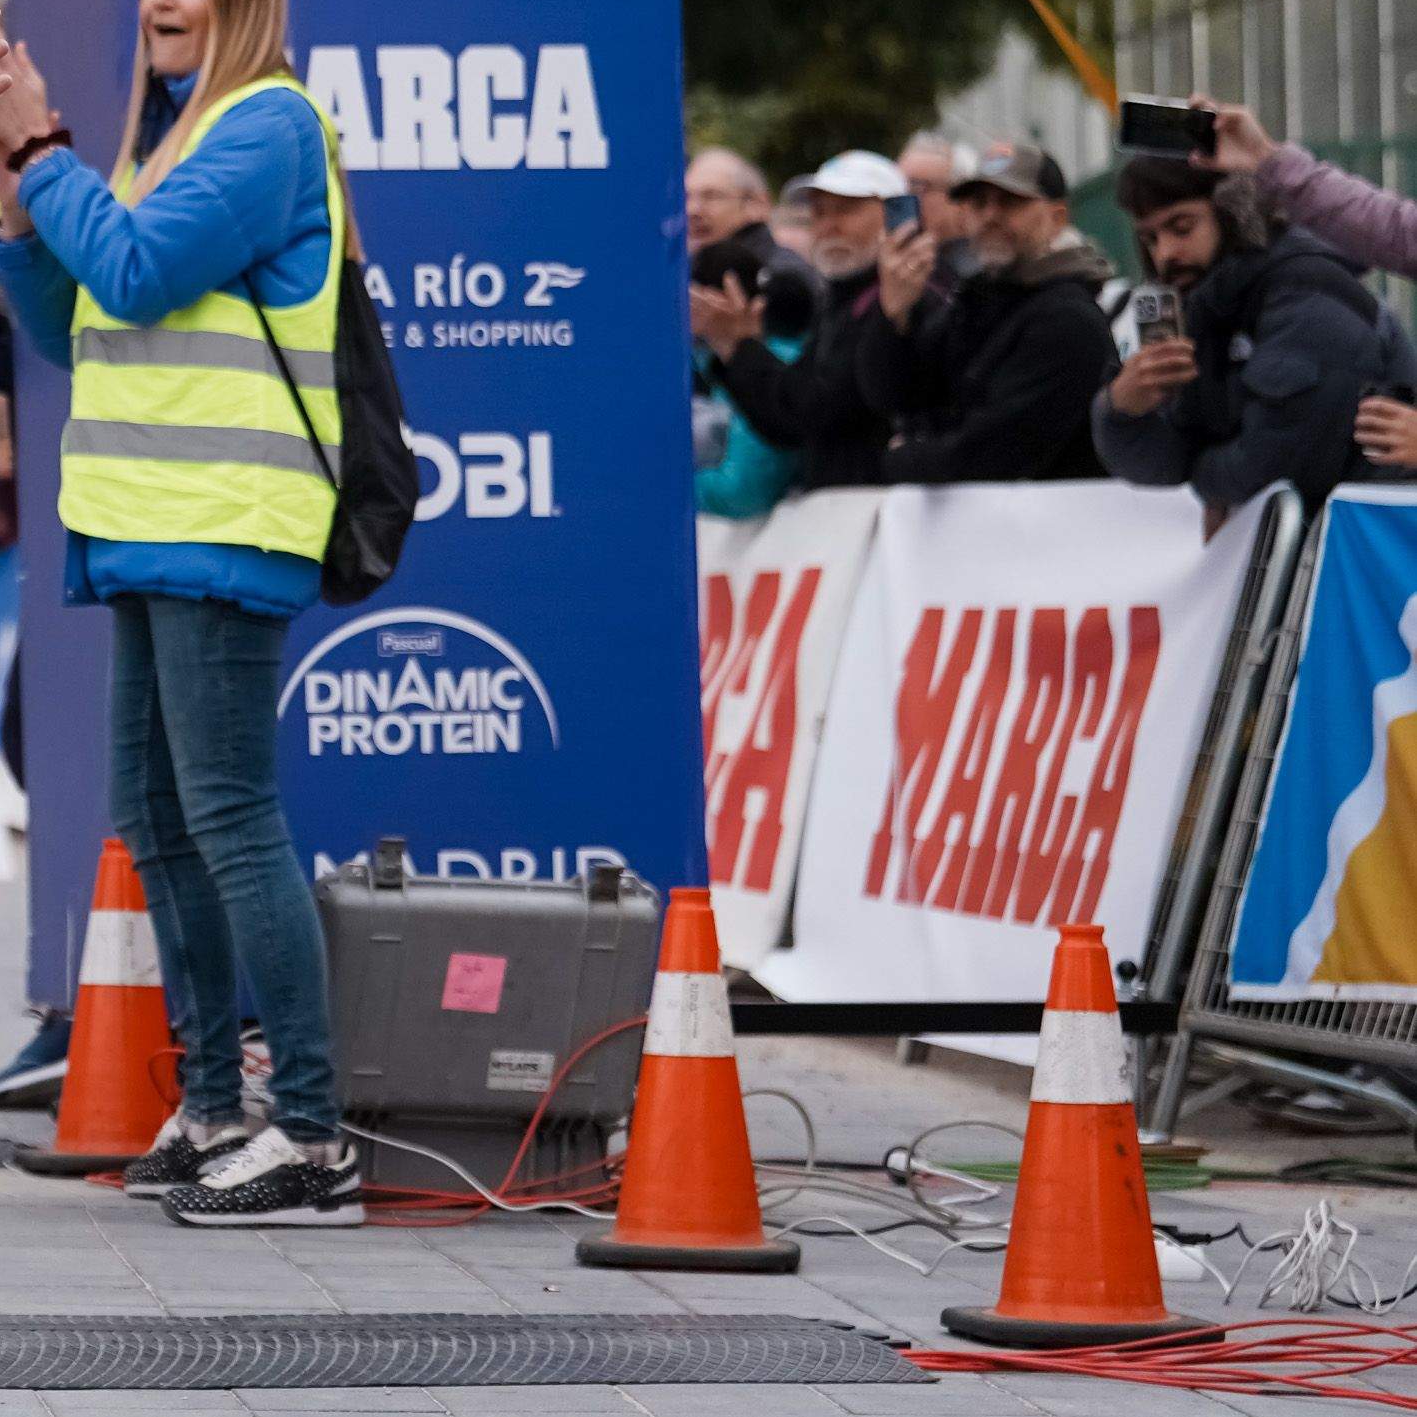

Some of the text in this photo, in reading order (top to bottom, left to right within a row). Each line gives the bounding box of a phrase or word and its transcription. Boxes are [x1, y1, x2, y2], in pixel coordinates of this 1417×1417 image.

[286, 43, 610, 172] ARCA
[414, 253, 503, 308] RÍO
[523, 261, 568, 308] 2
[404, 320, 424, 349] &
[433, 319, 574, 348] SHOPPING
[400, 422, 554, 522] OBI
[381, 634, 439, 651] Pascual
[308, 713, 522, 756] PROTEIN
[862, 605, 1162, 927] MARCA
